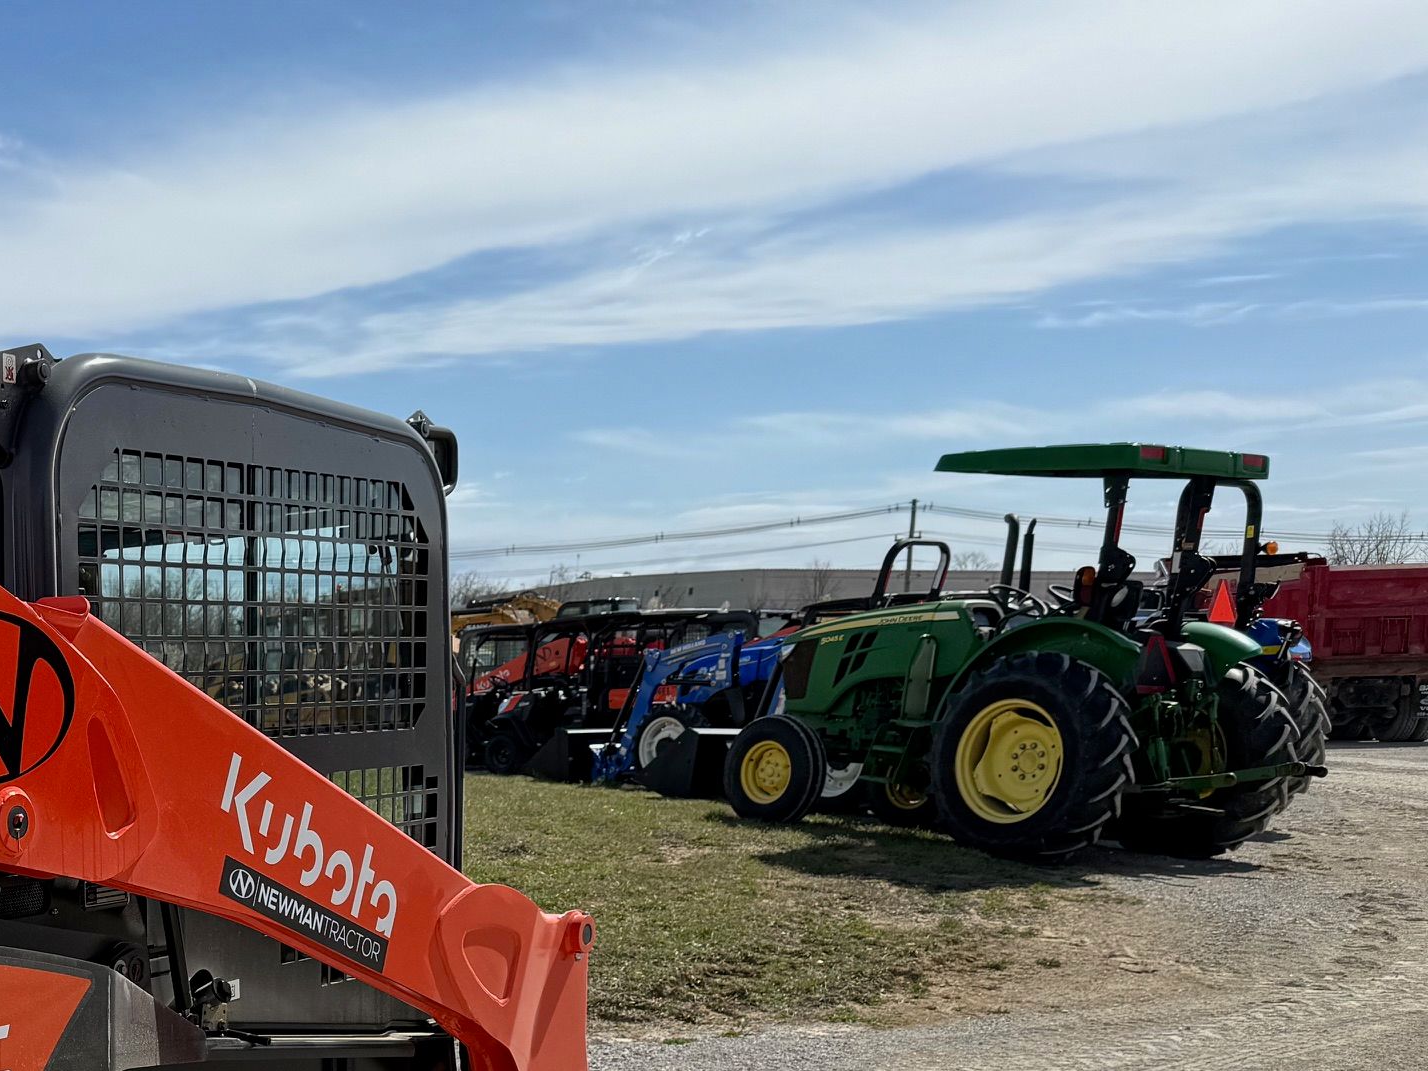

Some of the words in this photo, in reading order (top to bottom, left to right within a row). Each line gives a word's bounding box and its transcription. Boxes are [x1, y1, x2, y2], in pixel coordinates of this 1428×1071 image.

[879, 616, 899, 626] JOHN
[898, 614, 924, 624] DEERE
[221, 752, 397, 938] Kubota
